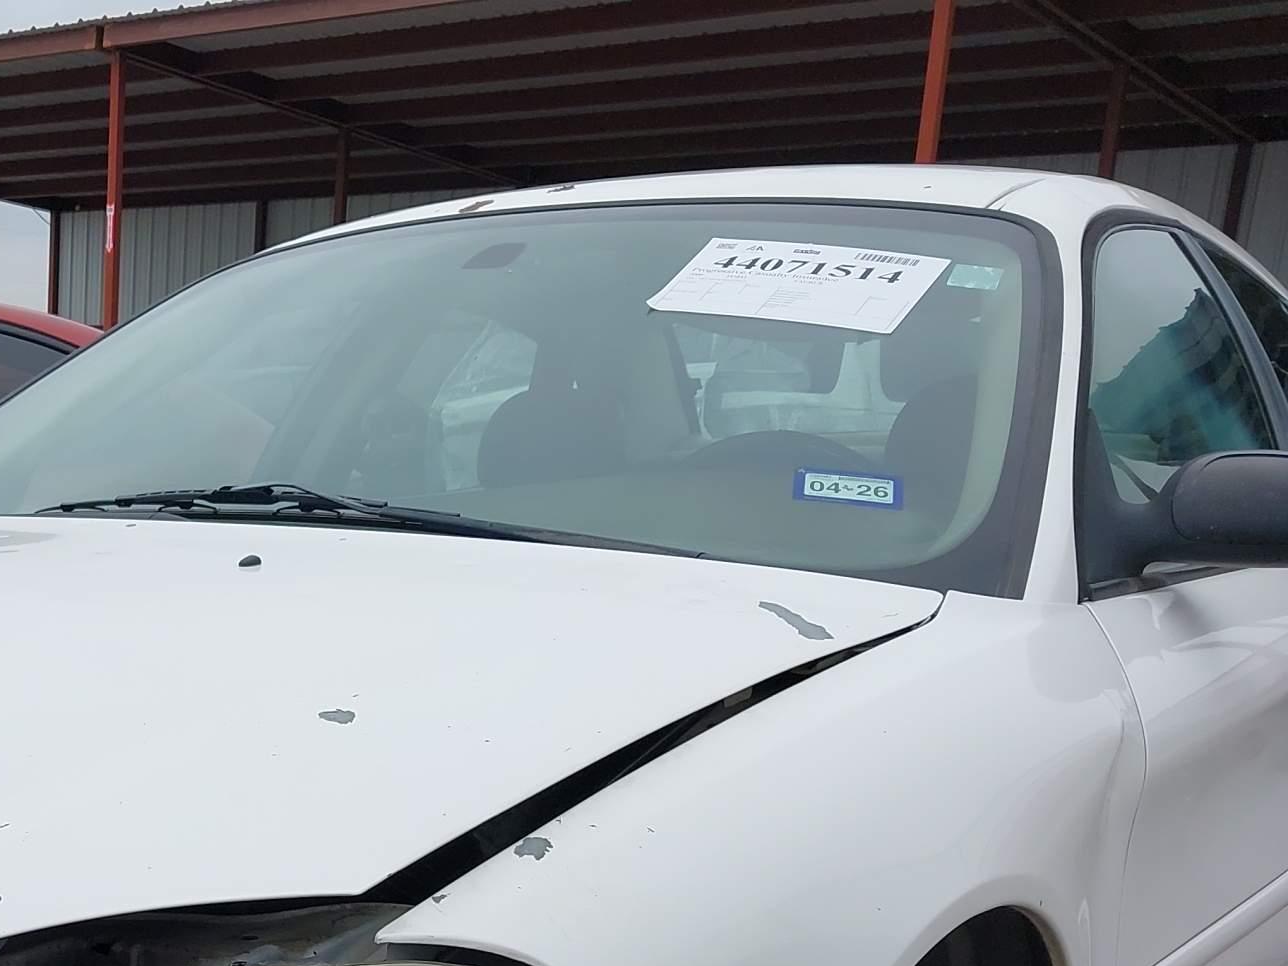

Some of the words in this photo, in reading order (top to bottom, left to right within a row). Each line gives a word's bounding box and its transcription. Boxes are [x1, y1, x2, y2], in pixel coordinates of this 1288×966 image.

[713, 254, 903, 285] 44071514
[809, 479, 842, 494] 04
[856, 483, 889, 499] 26
